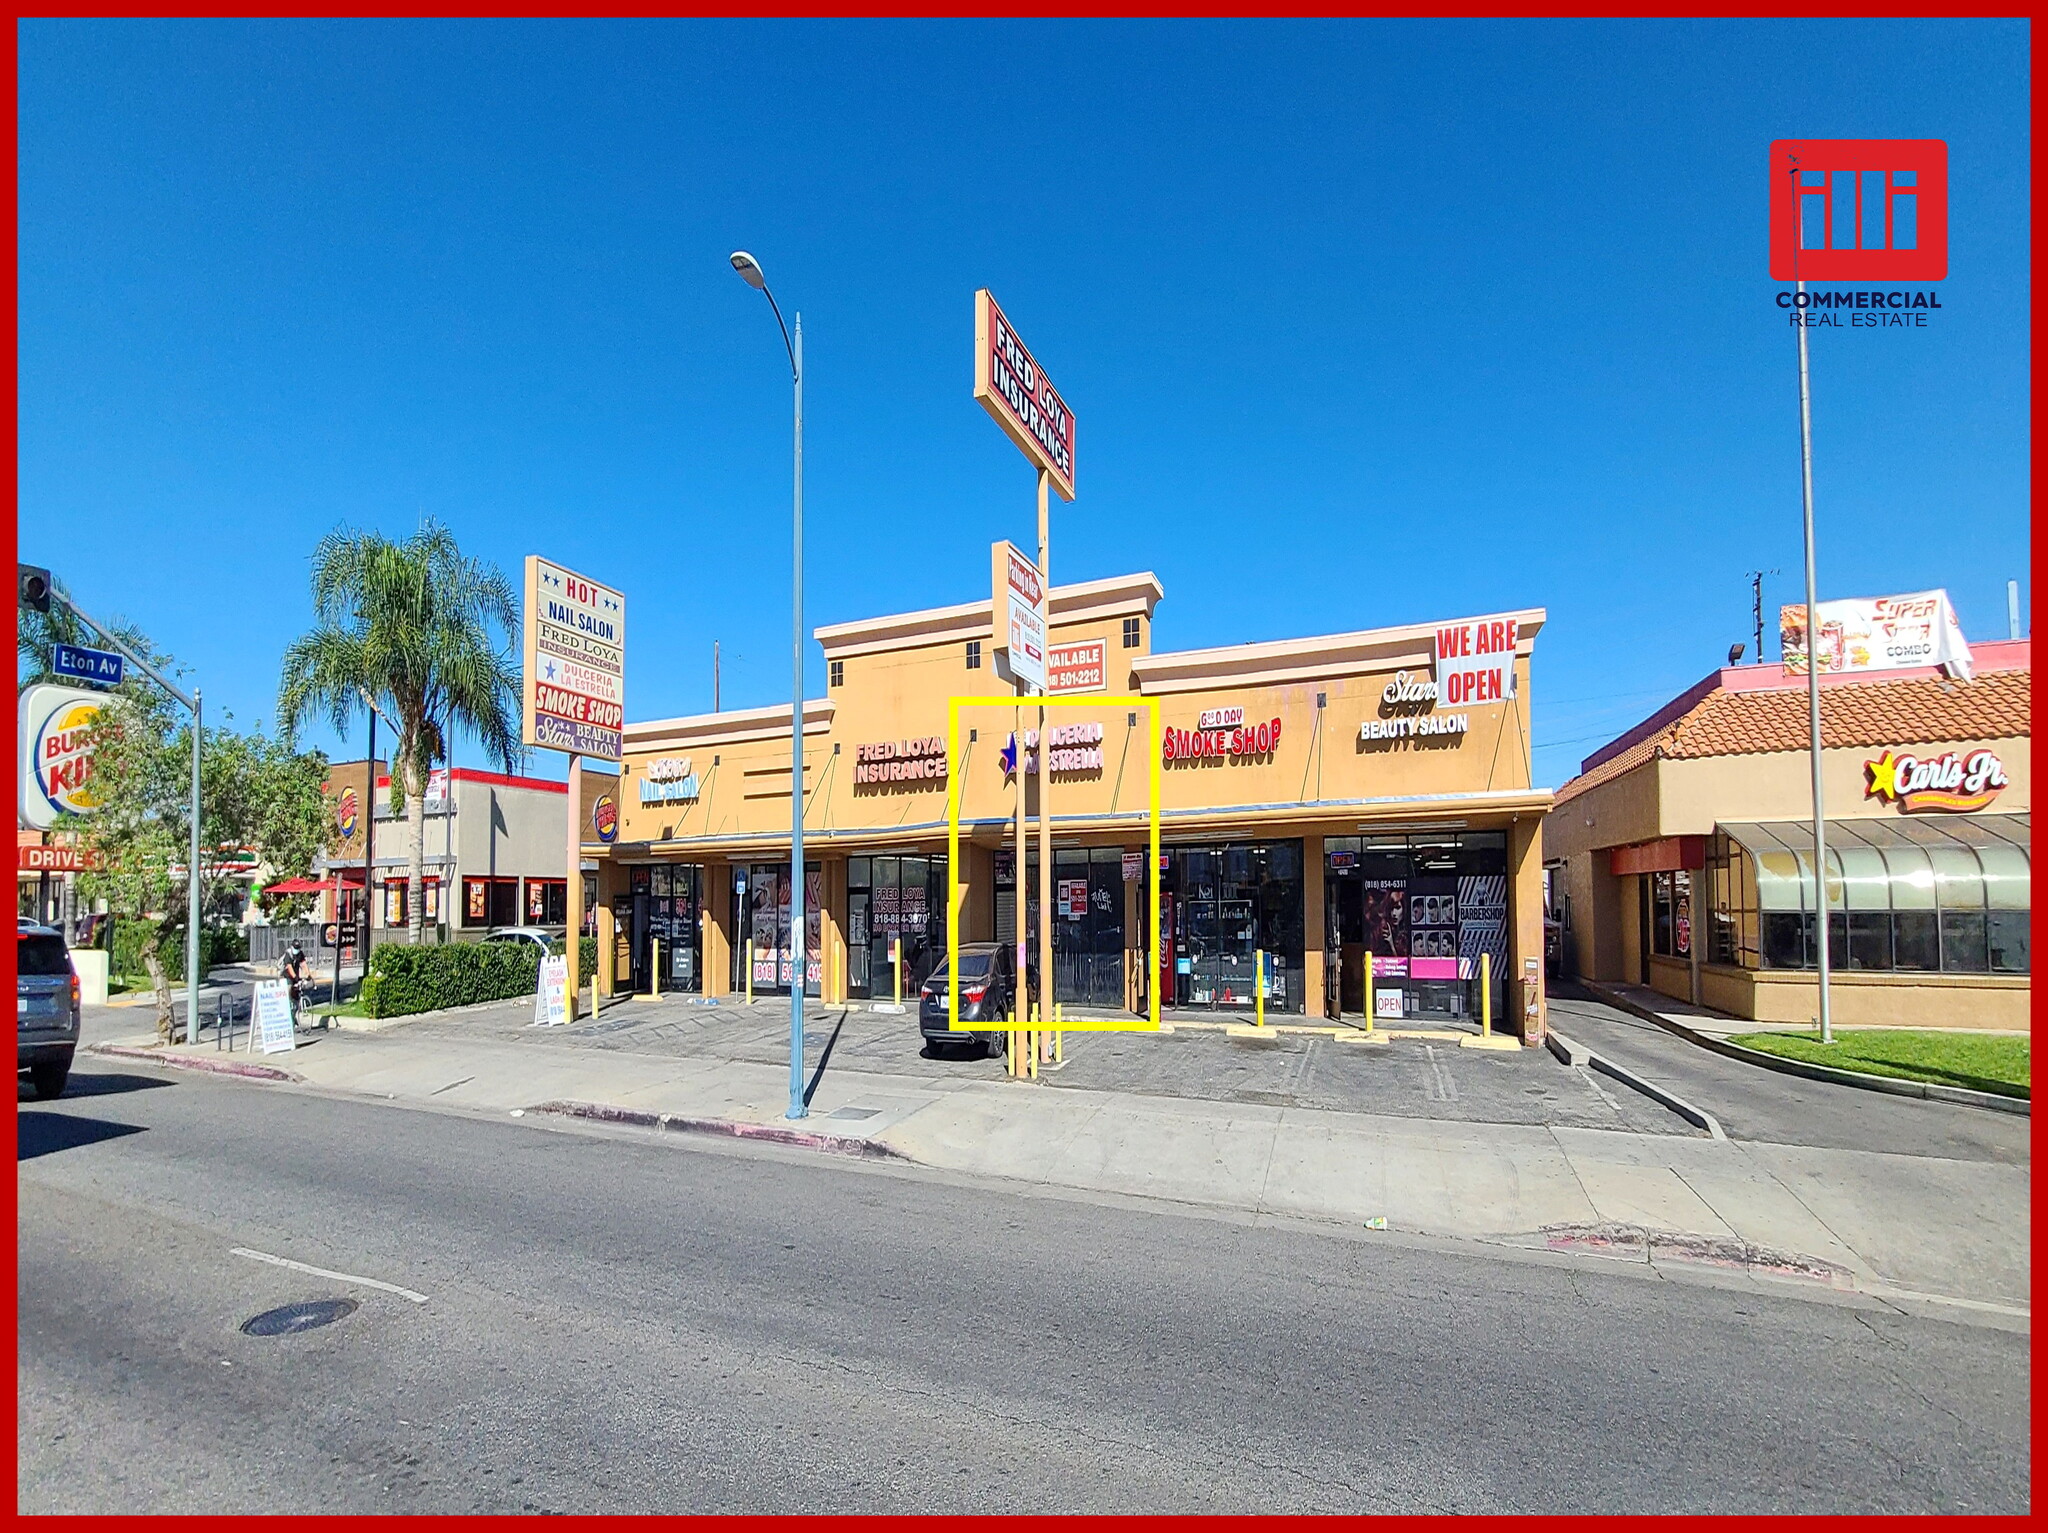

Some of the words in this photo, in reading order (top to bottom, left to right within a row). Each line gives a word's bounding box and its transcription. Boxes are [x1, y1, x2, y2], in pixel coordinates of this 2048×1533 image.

[996, 318, 1035, 392] FRED
[1038, 378, 1067, 441] LOYA
[993, 354, 1069, 474] INSURANCE
[566, 577, 598, 607] HOT
[548, 600, 575, 627] NAIL
[578, 613, 613, 641] SALON
[1014, 606, 1040, 635] AVAILABLE
[1872, 599, 1937, 621] SUPER
[541, 624, 580, 648] FRED
[584, 639, 619, 663] LOYA
[1437, 625, 1471, 659] WE
[1475, 619, 1516, 655] ARE
[1887, 643, 1932, 657] COMBO
[61, 650, 95, 672] Eton
[99, 661, 118, 676] Av
[542, 641, 618, 671] INSURANCE
[1049, 648, 1099, 668] VAILABLE
[560, 675, 572, 687] LA
[575, 678, 616, 700] ESTRELLA
[564, 663, 613, 687] DULCERIA
[1059, 669, 1099, 686] 501-2212
[1383, 670, 1438, 704] Stars
[1447, 668, 1501, 704] OPEN
[536, 685, 586, 720] SMOKE
[588, 699, 621, 728] SHOP
[1224, 708, 1242, 724] DAY
[536, 716, 575, 747] Stars
[576, 723, 620, 745] BEAUTY
[1164, 725, 1227, 760] SMOKE
[1231, 717, 1281, 756] SHOP
[1360, 716, 1416, 741] BEAUTY
[1419, 713, 1468, 735] SALON
[580, 738, 616, 757] SALON
[856, 741, 896, 761] FRED
[900, 736, 944, 758] LOYA
[1049, 746, 1103, 771] STRELLA
[853, 757, 948, 783] INSURANCE
[1893, 752, 1967, 794] Carl's
[1964, 752, 2009, 792] Jr.
[640, 777, 663, 802] NAIL
[665, 772, 698, 800] SALON
[29, 850, 84, 867] DRIVE
[875, 887, 899, 900] FRED
[902, 887, 925, 900] LOYA
[1364, 879, 1379, 890] (818)
[873, 900, 926, 913] INSURANCE
[1460, 907, 1504, 921] BARBERSHOP
[753, 962, 777, 983] (818)
[1378, 997, 1401, 1011] OPEN
